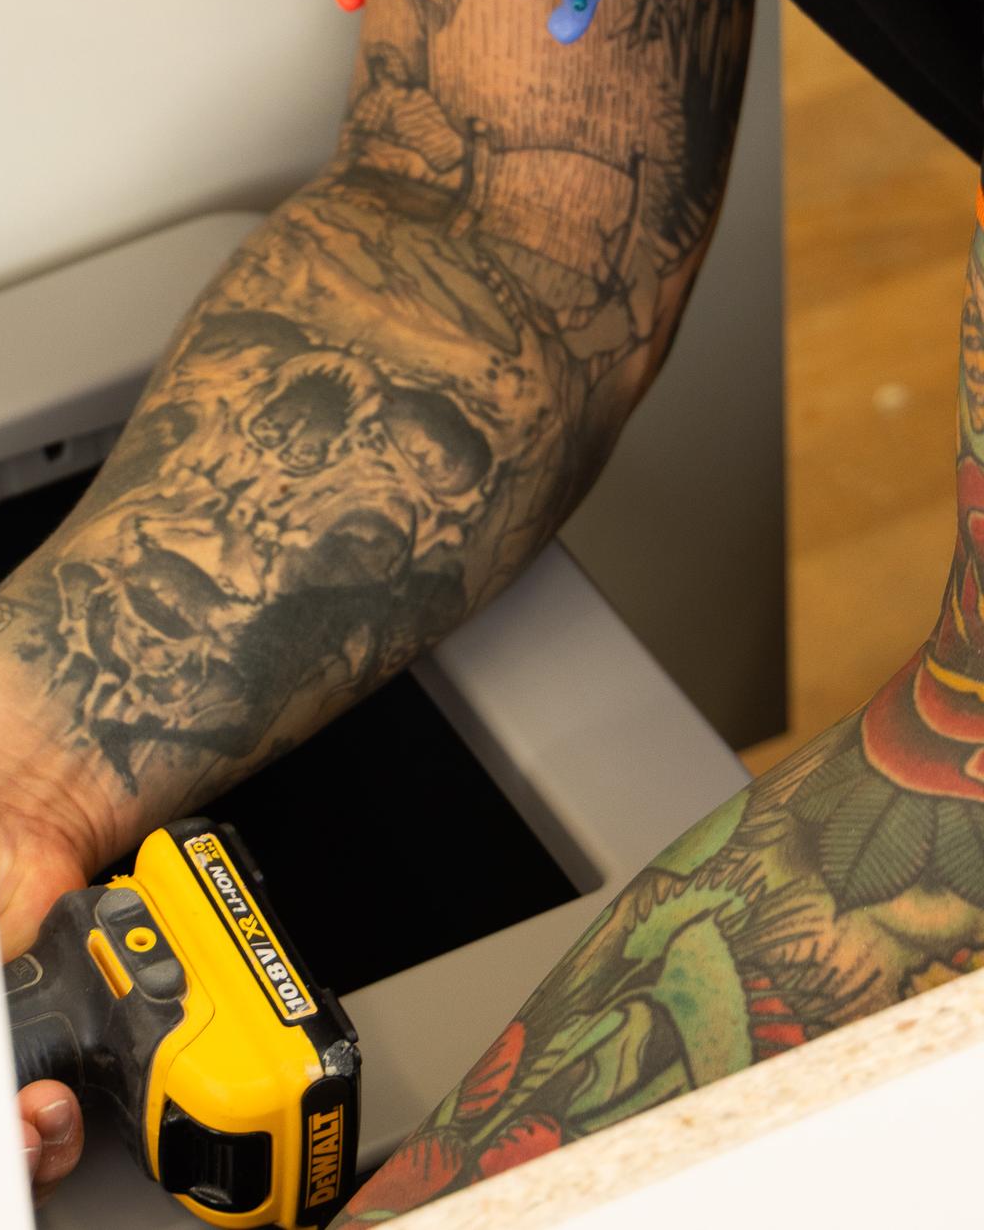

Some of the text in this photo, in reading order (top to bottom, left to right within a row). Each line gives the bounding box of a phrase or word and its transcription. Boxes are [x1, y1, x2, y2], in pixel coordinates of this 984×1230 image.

[209, 865, 248, 914] LI-ION
[238, 913, 266, 941] XR
[309, 1110, 339, 1208] DEWALT
